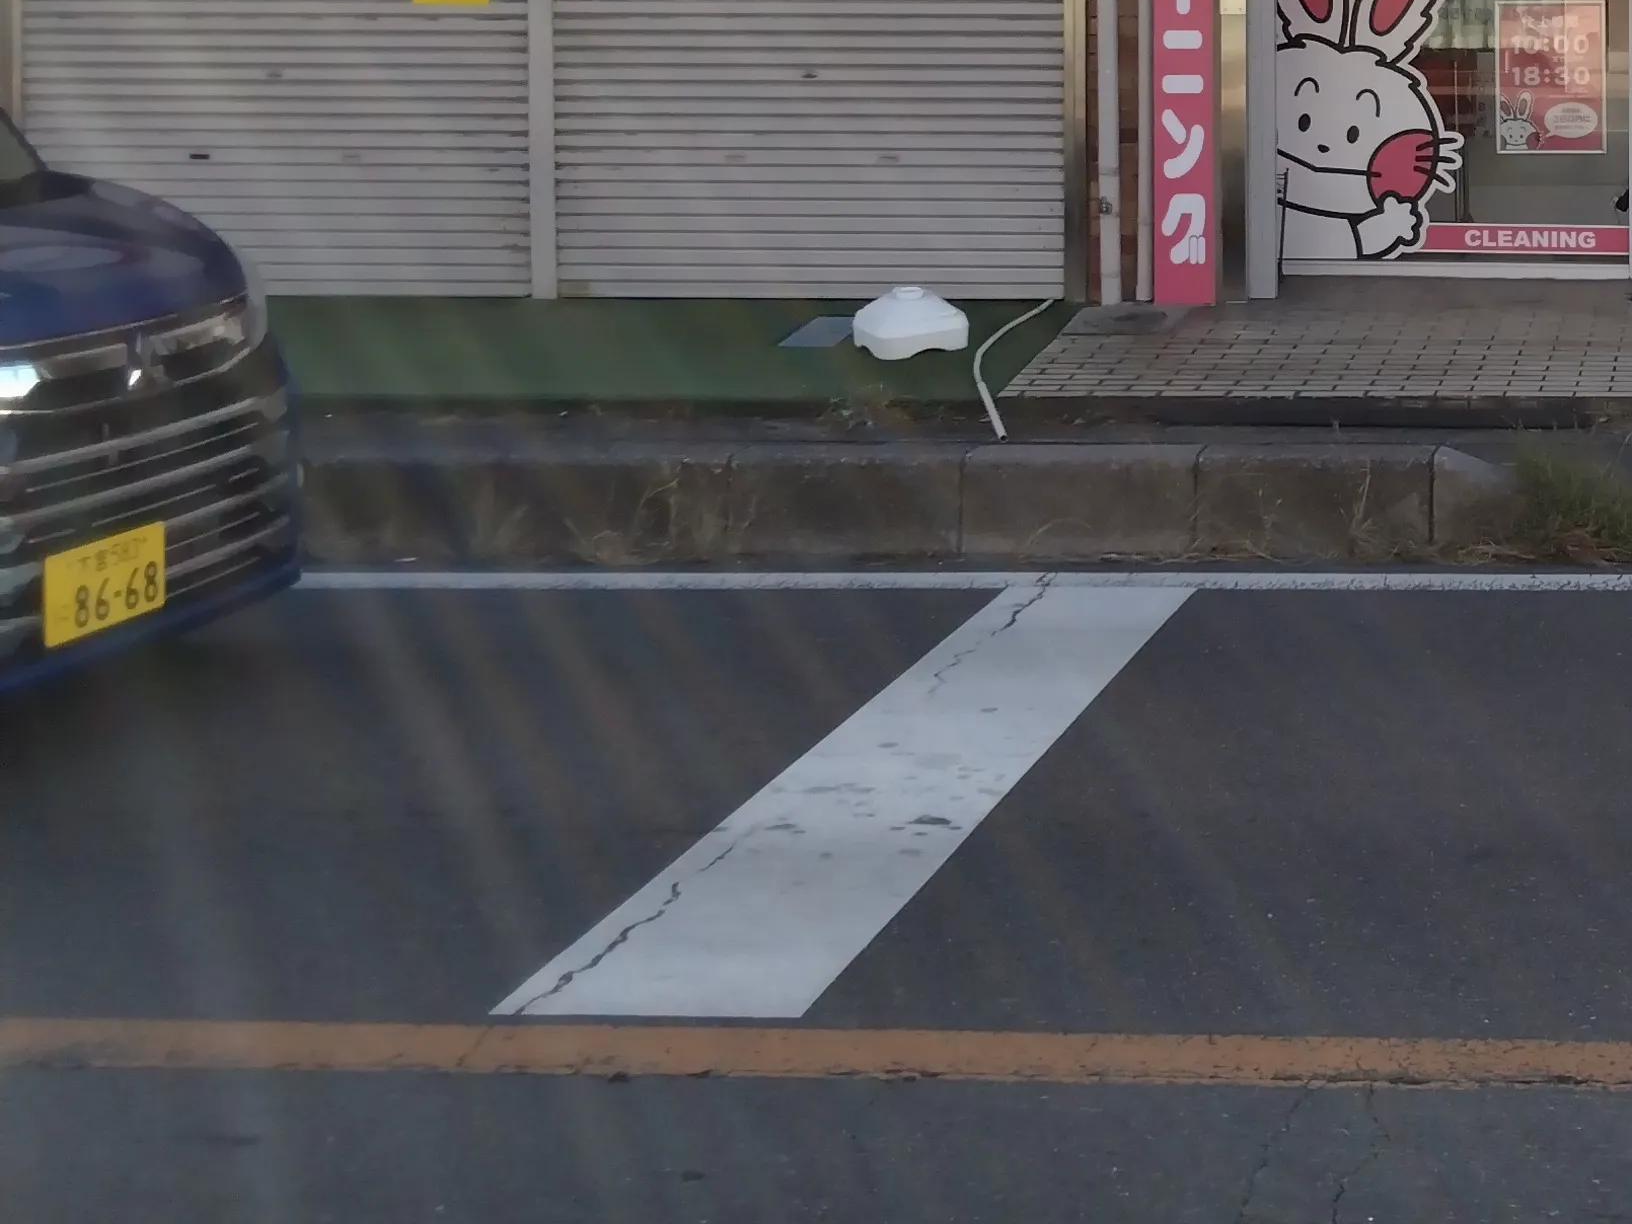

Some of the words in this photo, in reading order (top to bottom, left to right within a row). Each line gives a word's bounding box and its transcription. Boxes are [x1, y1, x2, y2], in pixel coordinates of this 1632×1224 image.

[1511, 34, 1589, 54] 10:00
[1512, 66, 1590, 86] 18:30
[1464, 229, 1597, 248] CLEANING
[75, 560, 158, 629] 86-68
